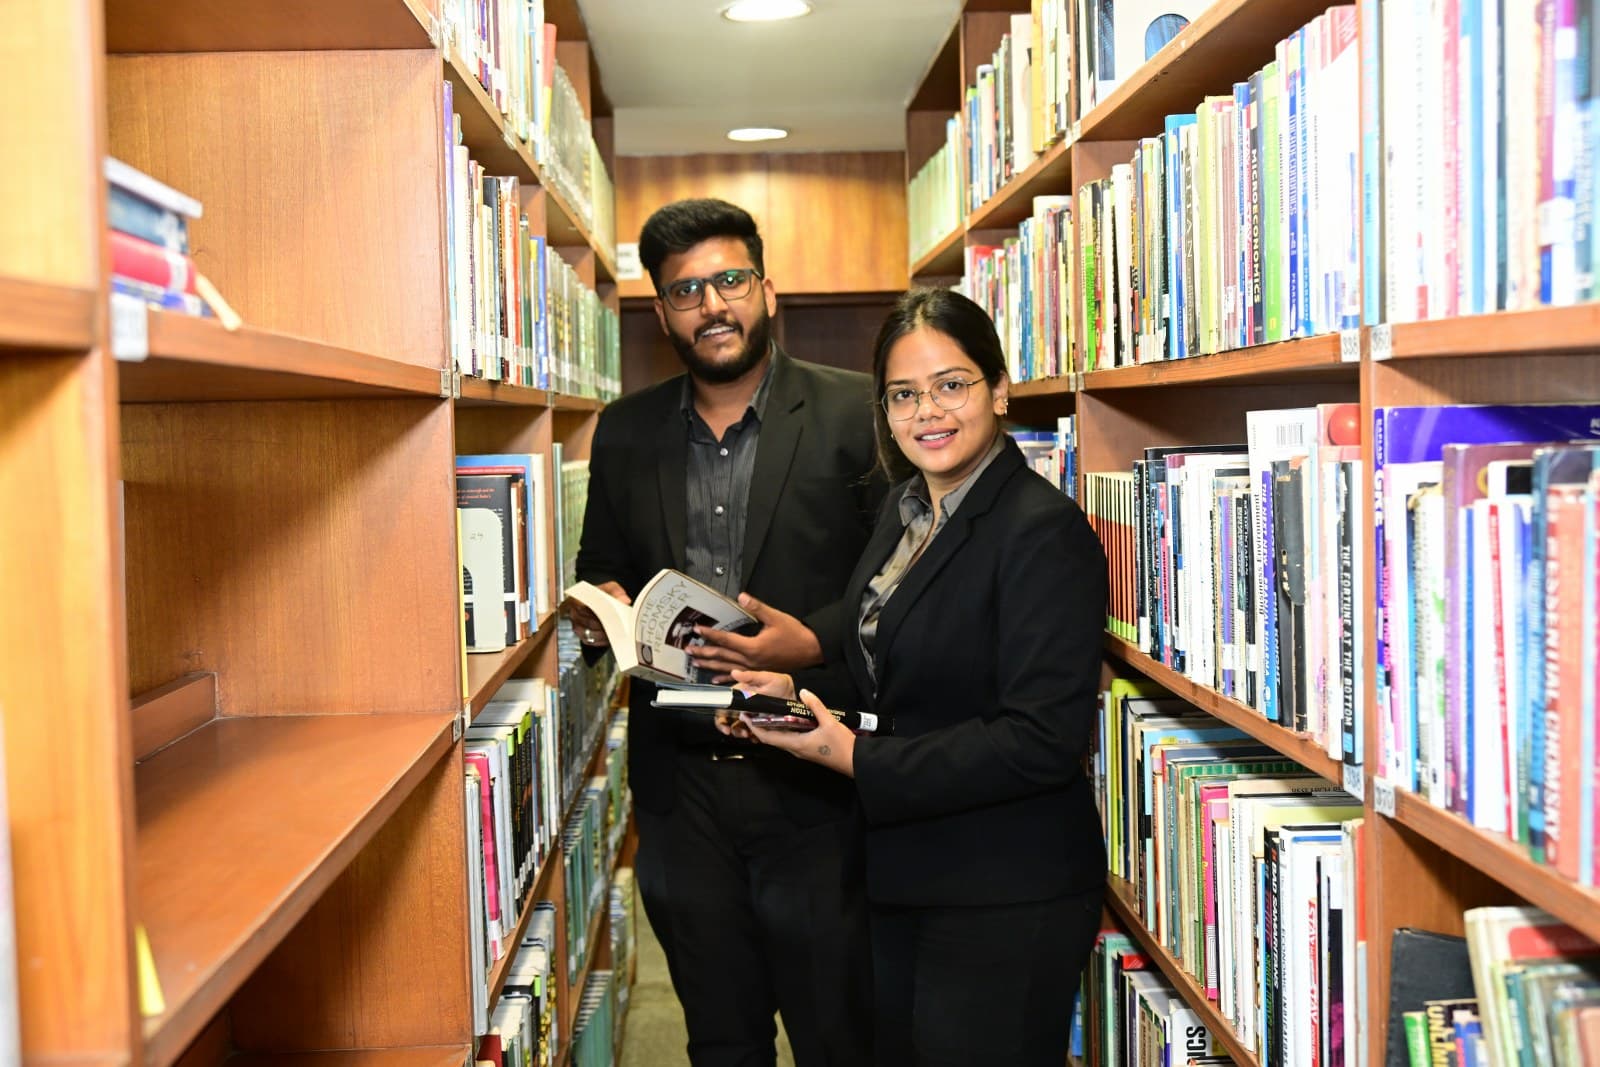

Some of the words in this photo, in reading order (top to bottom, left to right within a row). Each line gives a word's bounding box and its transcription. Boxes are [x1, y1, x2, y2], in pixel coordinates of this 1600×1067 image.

[1251, 149, 1263, 304] MICROECONOMICS
[1343, 545, 1351, 567] THE
[640, 597, 656, 625] THE
[653, 592, 691, 653] READER
[1343, 572, 1352, 625] FORTUNE
[1344, 630, 1352, 647] AT
[1546, 559, 1561, 702] ESSENTIAL
[1344, 651, 1352, 673] THE
[1344, 678, 1353, 727] BOTTOM
[1545, 710, 1561, 842] CHOMSKY
